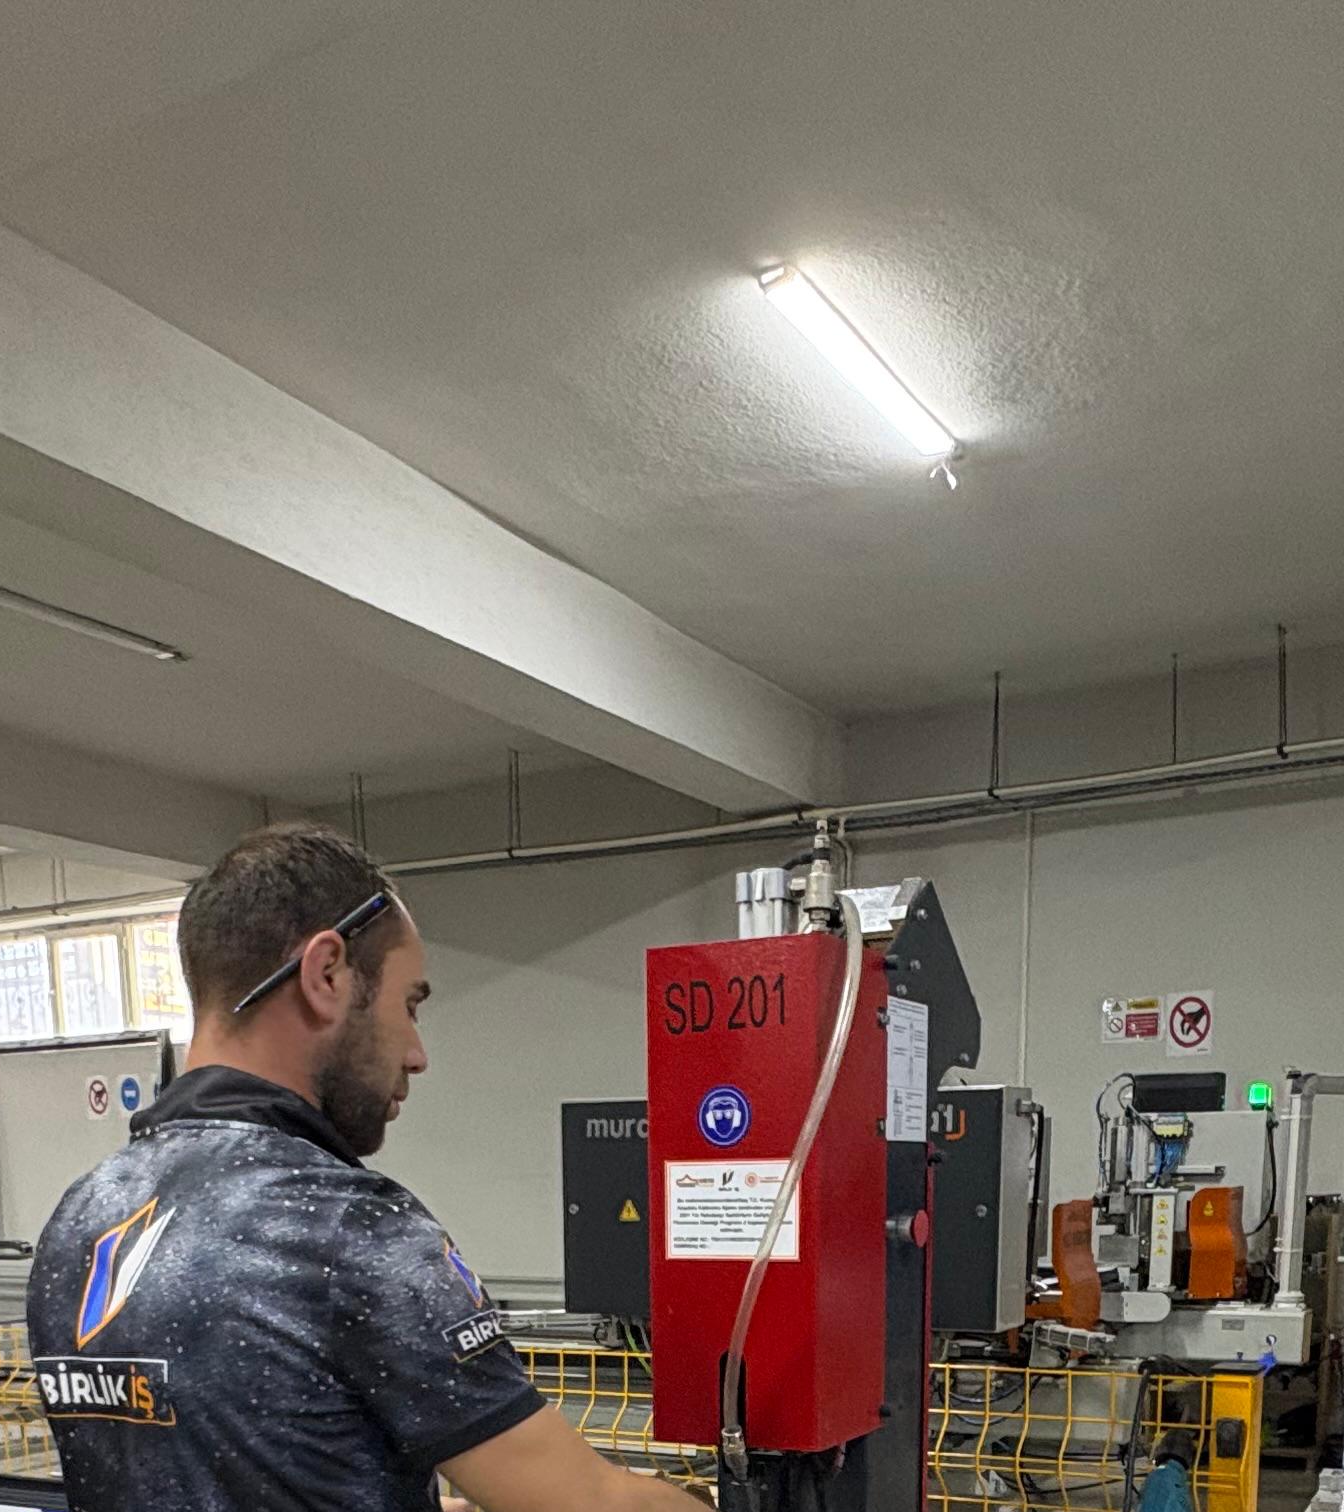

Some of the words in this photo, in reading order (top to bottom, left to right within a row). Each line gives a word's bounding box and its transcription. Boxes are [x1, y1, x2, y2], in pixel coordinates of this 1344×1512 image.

[664, 982, 715, 1036] SD
[727, 972, 785, 1031] 201
[40, 1362, 129, 1406] BİRLİK
[129, 1363, 155, 1419] İŞ
